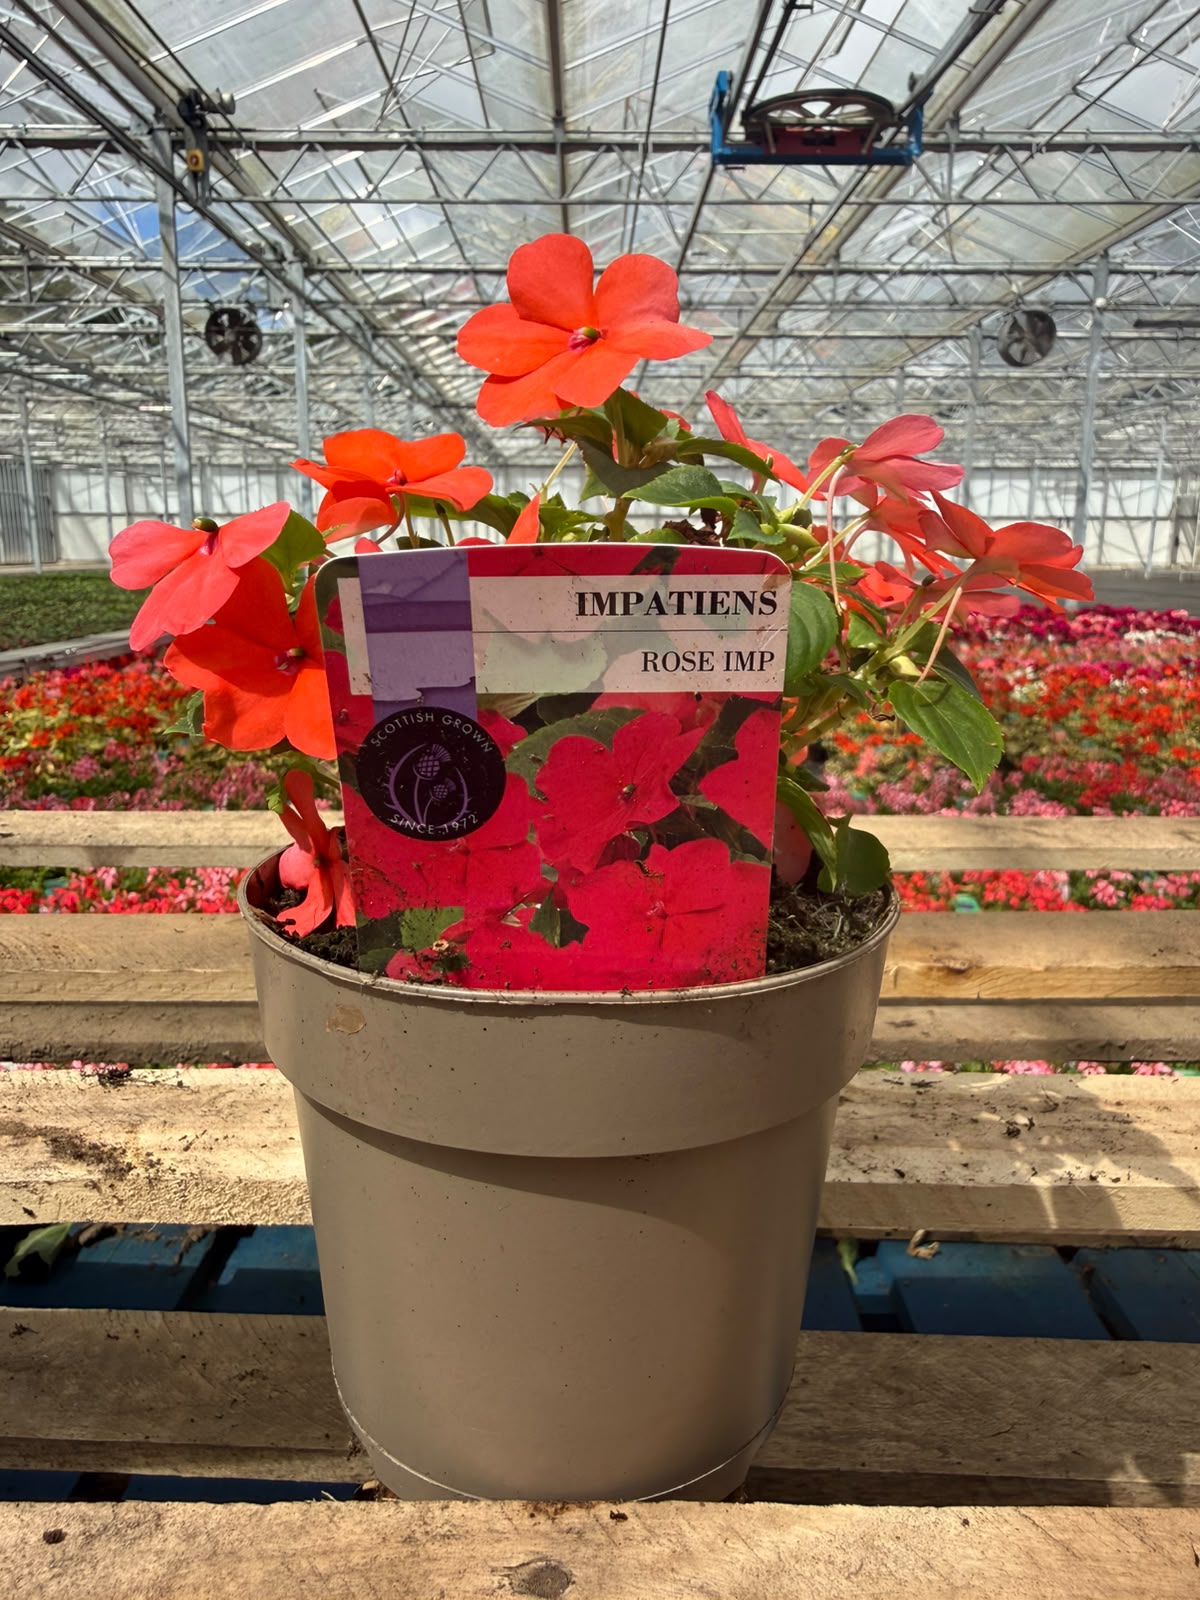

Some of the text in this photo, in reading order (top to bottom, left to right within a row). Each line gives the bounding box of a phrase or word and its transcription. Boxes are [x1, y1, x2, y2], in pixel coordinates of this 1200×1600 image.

[575, 590, 778, 616] IMPATIENS
[641, 651, 775, 673] ROSE IMP
[371, 712, 494, 752] SCOTTISH GROWN
[390, 814, 478, 834] SINCE 1972
